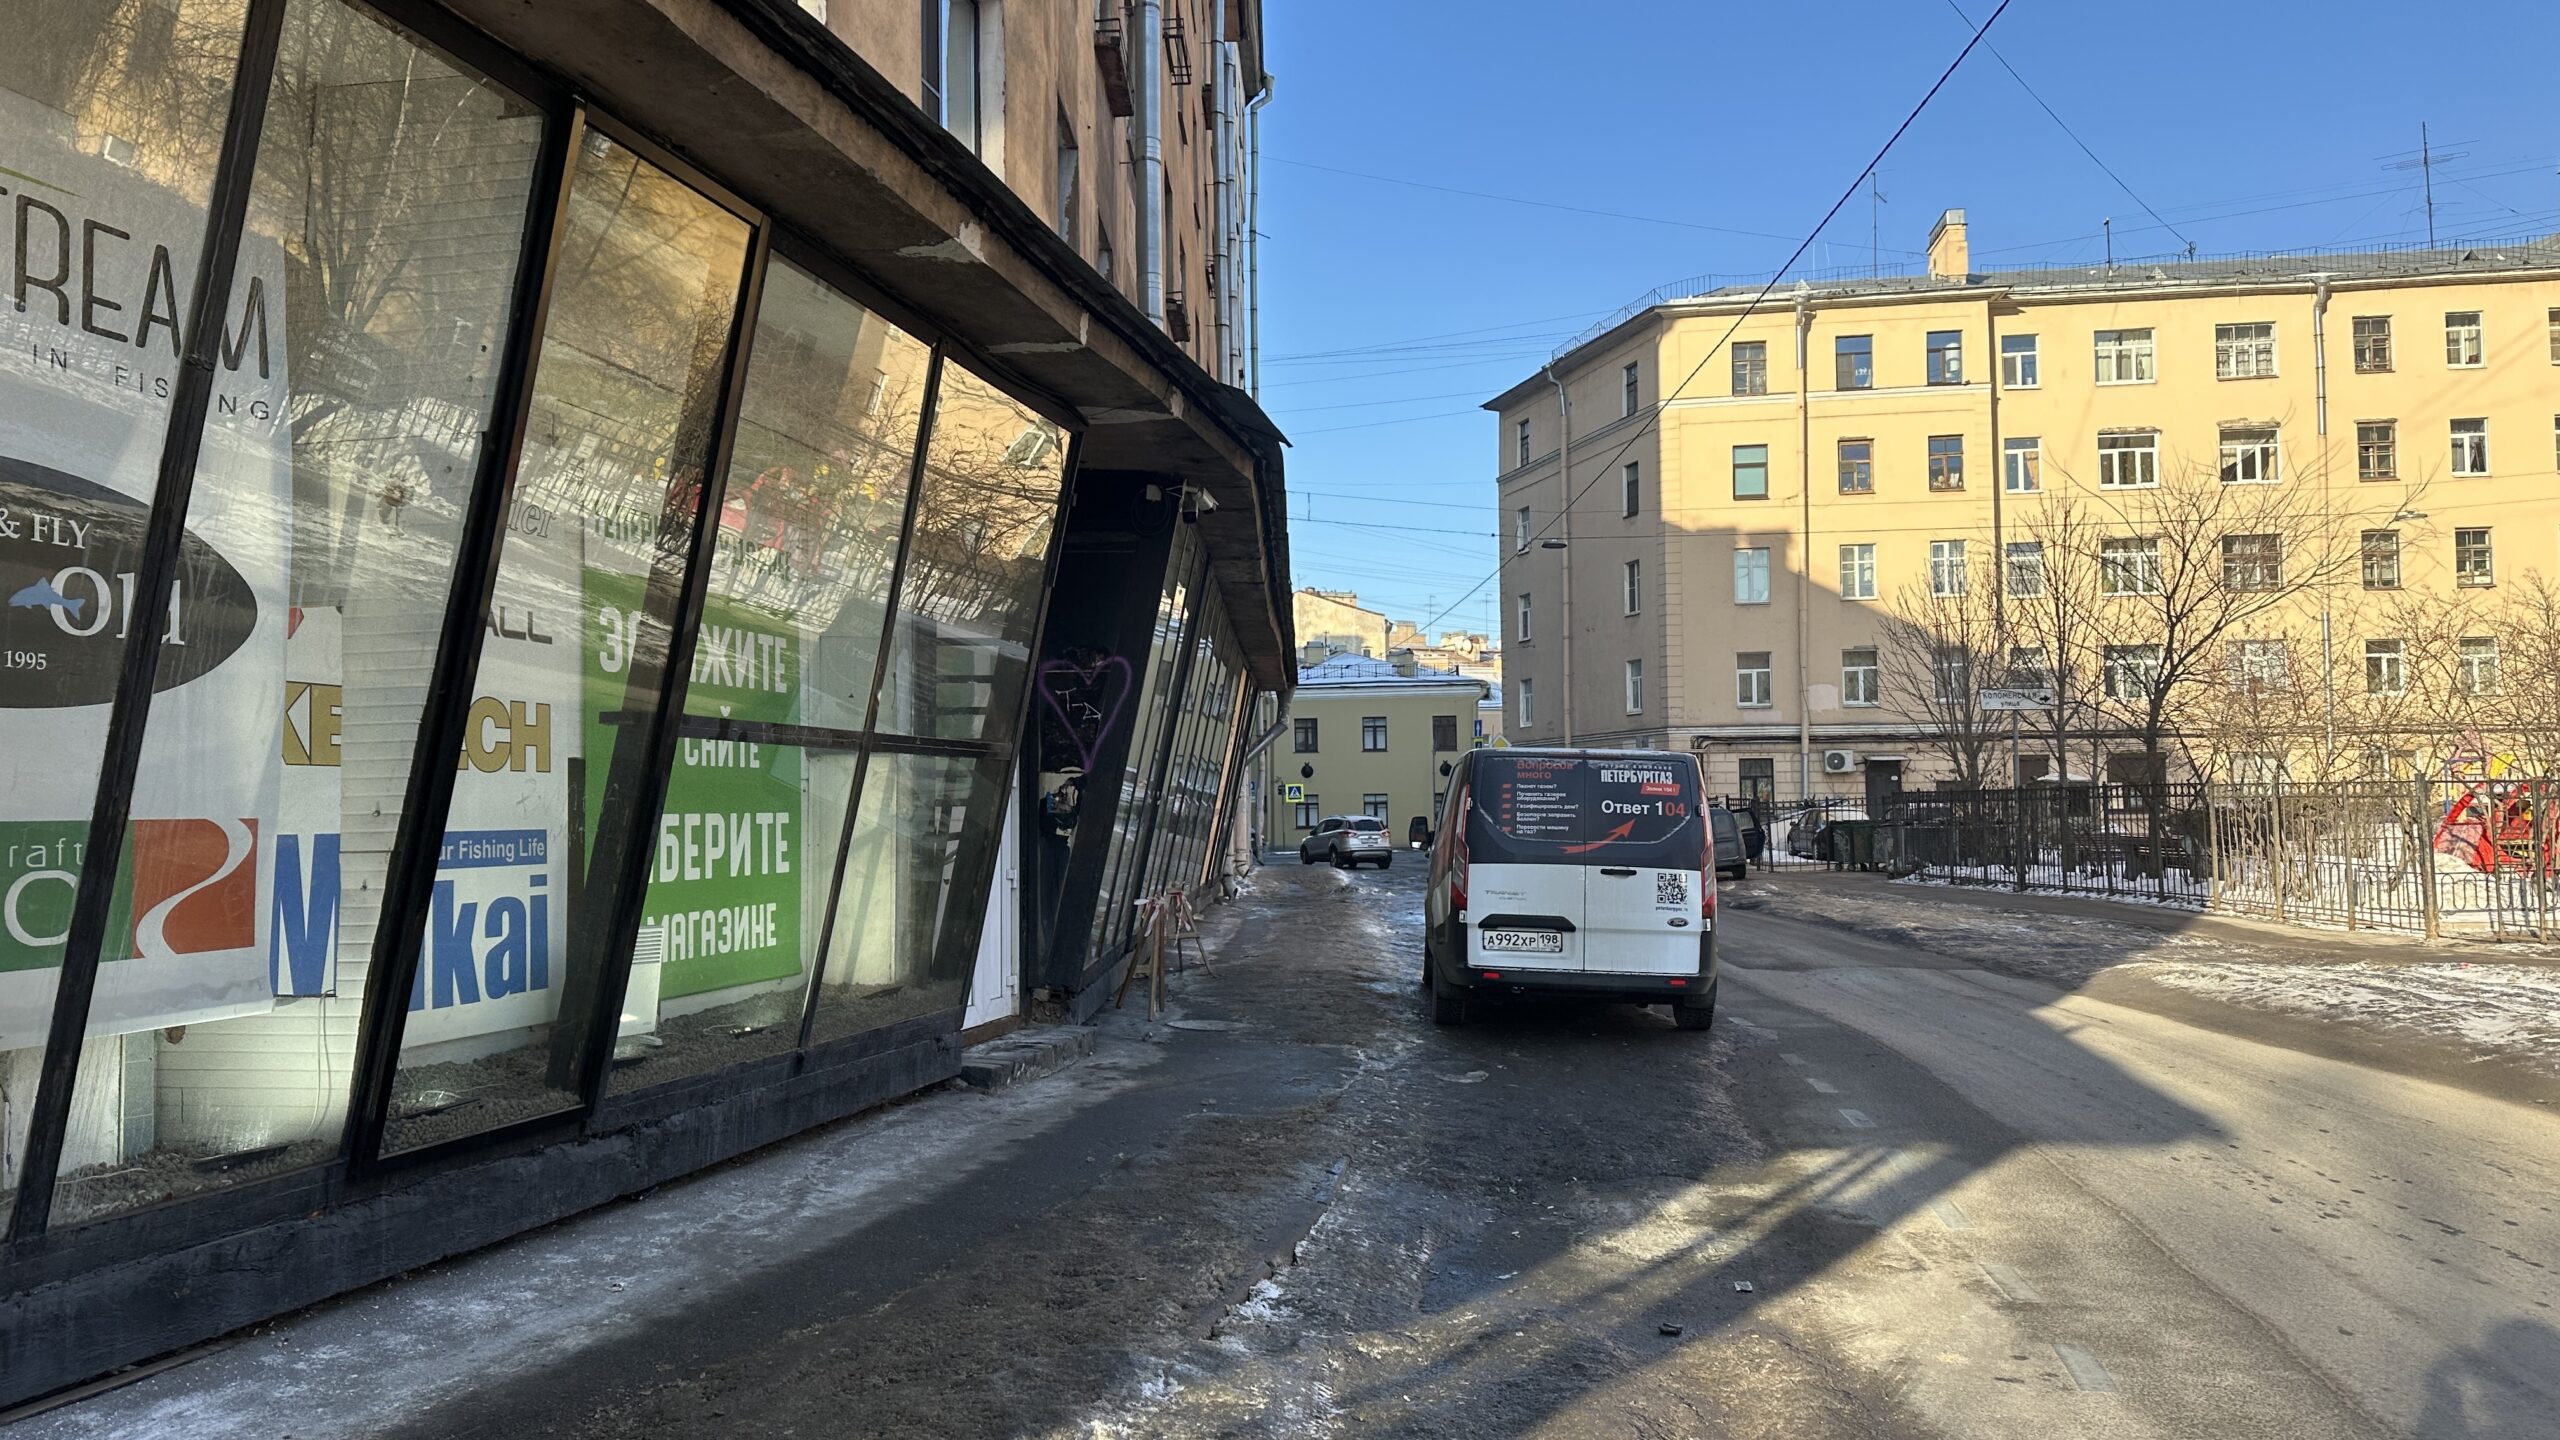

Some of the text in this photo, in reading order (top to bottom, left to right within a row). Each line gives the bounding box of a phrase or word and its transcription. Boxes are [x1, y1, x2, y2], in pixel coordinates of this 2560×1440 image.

[0, 184, 270, 380] REAM
[33, 344, 270, 421] IN FISNG
[31, 513, 90, 549] FLY
[4, 650, 47, 671] 1995
[599, 606, 787, 693] ЗЖИТЕ
[282, 681, 551, 774] KECH
[1516, 771, 1552, 779] много
[1600, 769, 1673, 784] ПЕТЕРБУРГГАЗ
[1601, 799, 1686, 817] Ответ 104
[459, 839, 515, 862] Fishing
[519, 837, 545, 857] Life
[649, 811, 790, 884] БЕРИТЕ
[270, 833, 549, 1011] Mkai
[646, 902, 777, 963] МАГАЗИНЕ
[1487, 933, 1558, 947] А992ХР 198
